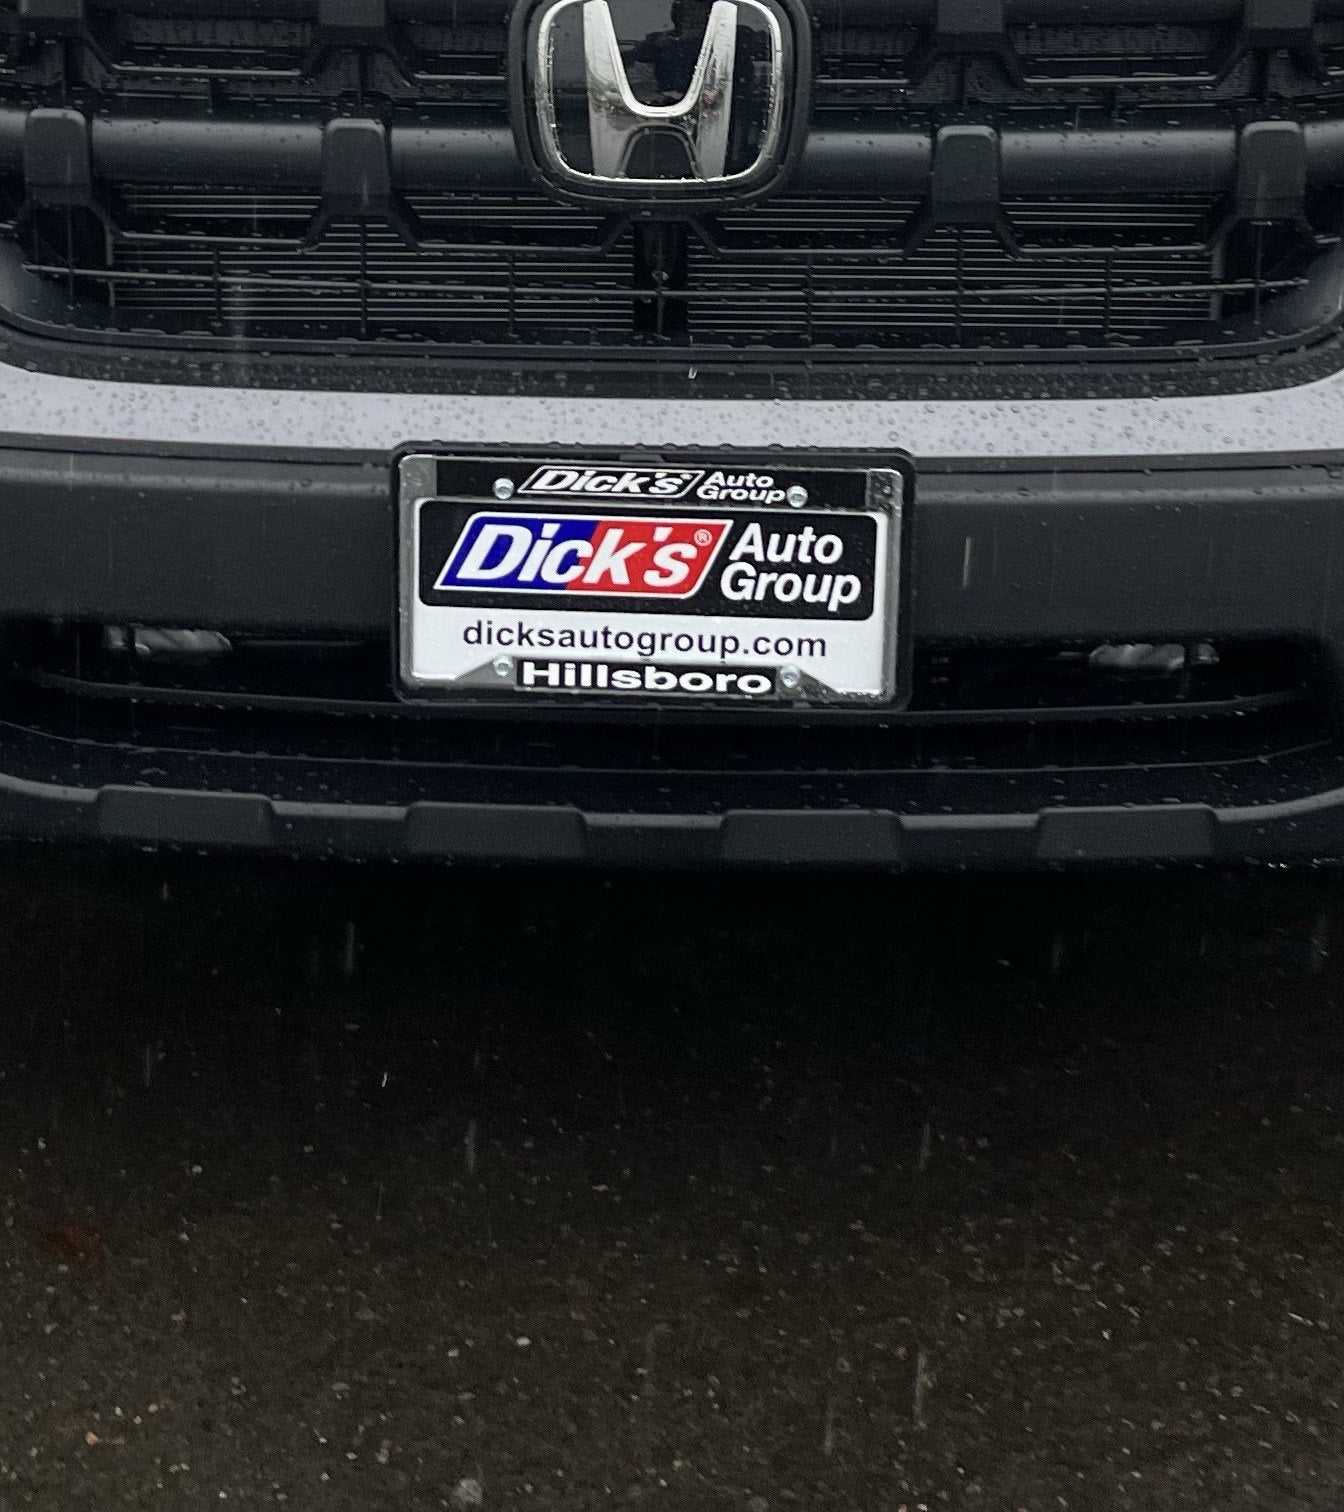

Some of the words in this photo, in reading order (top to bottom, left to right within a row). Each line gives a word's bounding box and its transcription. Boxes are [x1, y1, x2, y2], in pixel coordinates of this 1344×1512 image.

[696, 485, 786, 504] Group
[704, 471, 775, 488] Auto
[729, 522, 843, 565] Auto
[720, 562, 861, 612] Group
[463, 620, 827, 658] dicksautogroup.com
[522, 661, 773, 694] Hillsboro
